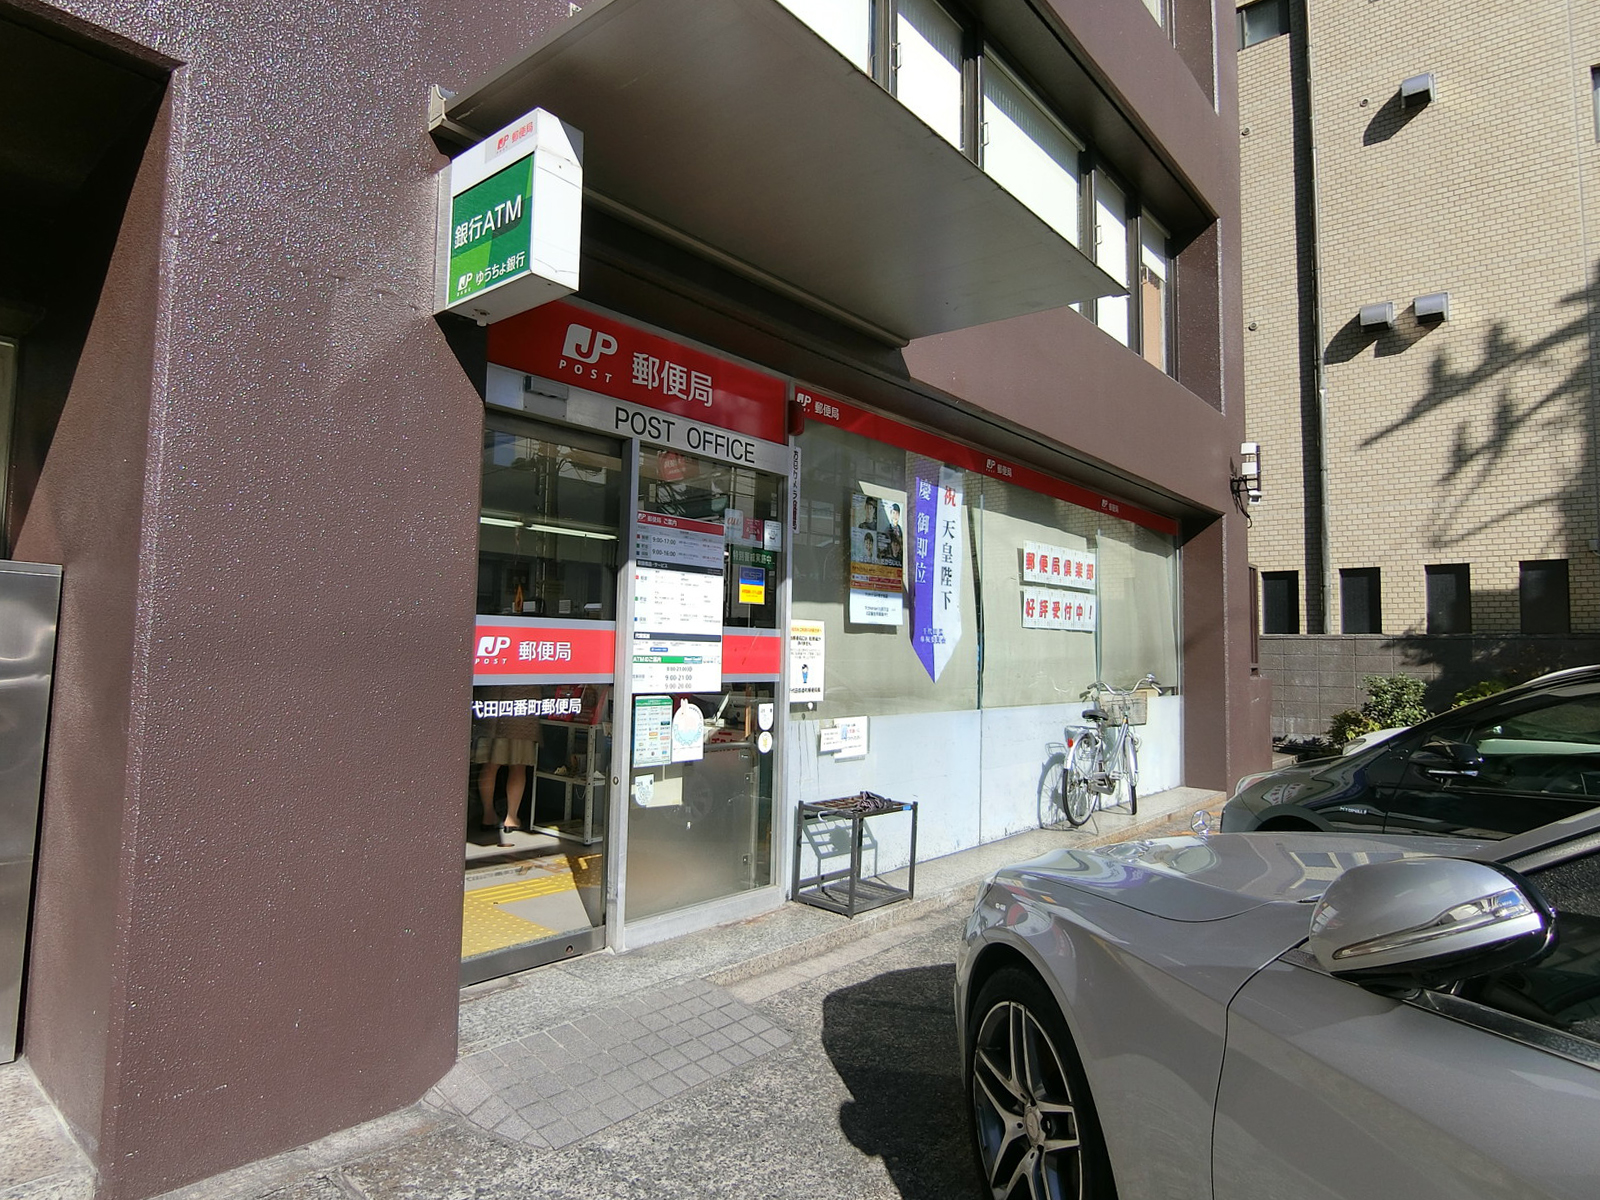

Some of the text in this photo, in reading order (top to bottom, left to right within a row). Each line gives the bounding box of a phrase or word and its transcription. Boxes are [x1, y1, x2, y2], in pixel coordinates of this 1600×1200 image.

[512, 122, 534, 143] 郵便局
[454, 194, 523, 249] 銀行ATM
[458, 251, 525, 291] JP ゆうちょ銀行
[559, 359, 613, 383] POST
[561, 323, 713, 408] JP 郵便局
[814, 401, 840, 420] 郵便局
[614, 406, 675, 443] POST
[687, 426, 756, 465] OFFICE
[915, 478, 932, 584] 慶 御即位
[941, 485, 957, 610] 祝 天皇陛下
[743, 571, 762, 580] CSP
[477, 636, 572, 661] JP 郵便局
